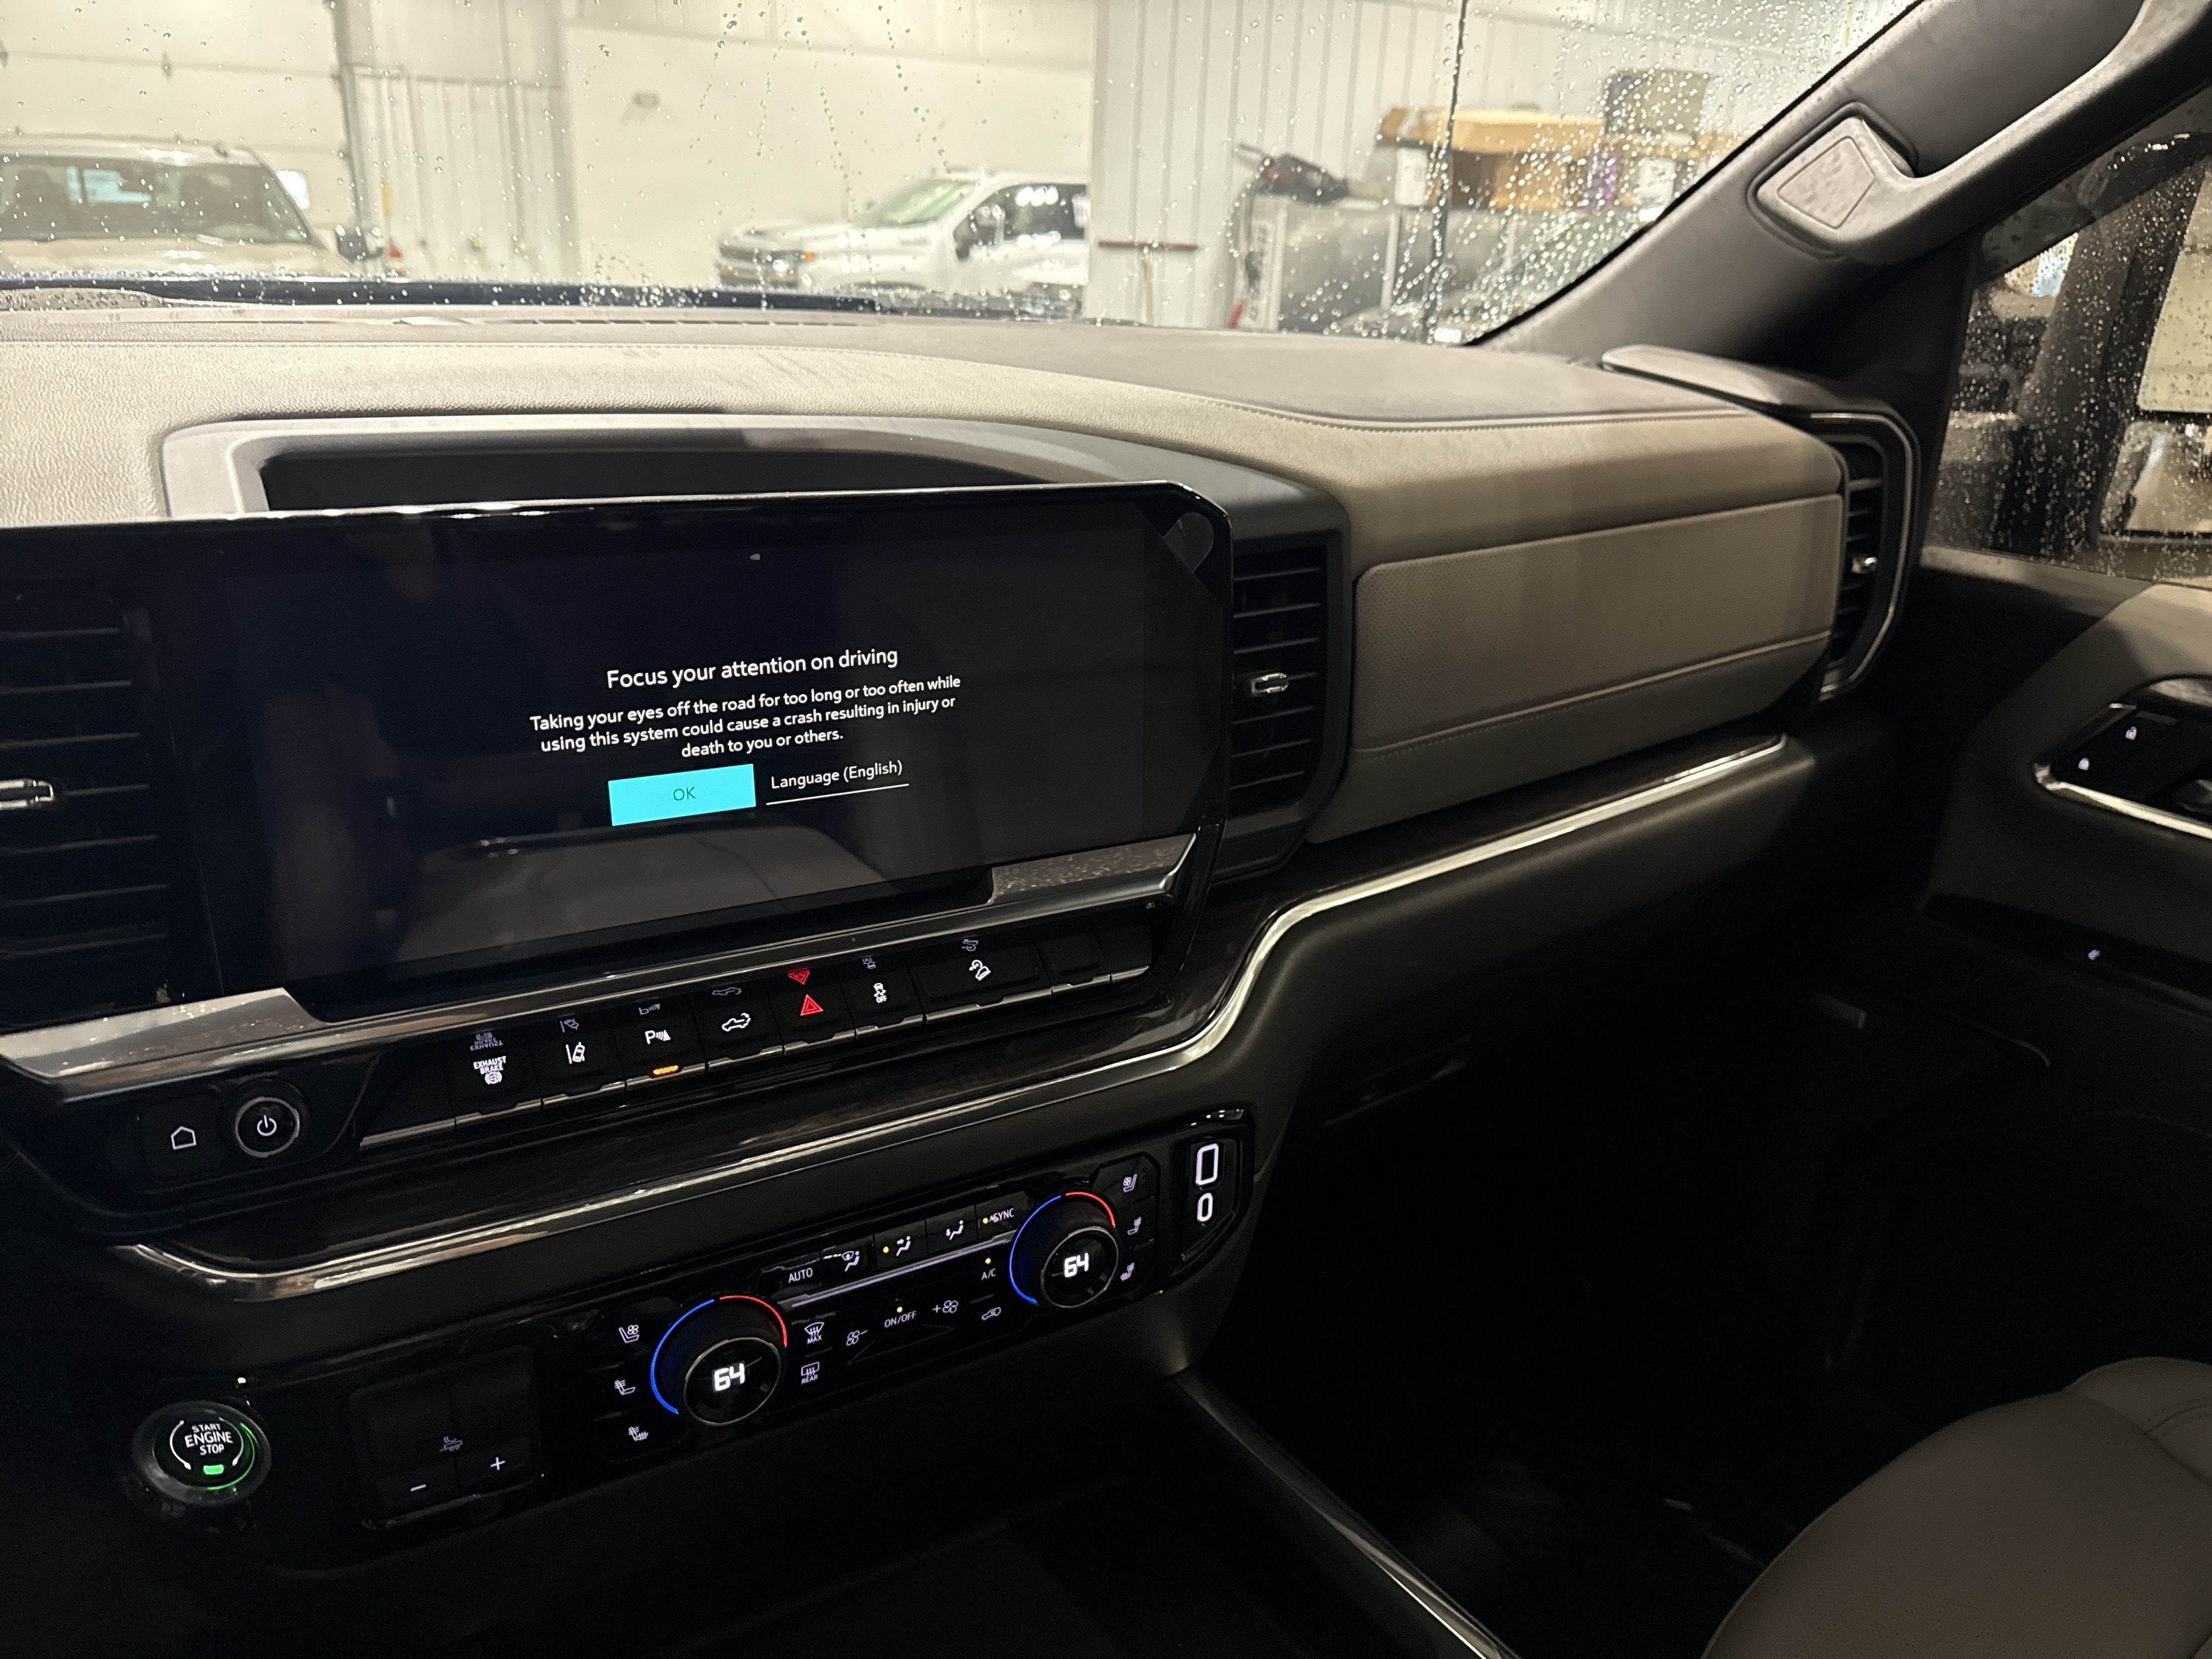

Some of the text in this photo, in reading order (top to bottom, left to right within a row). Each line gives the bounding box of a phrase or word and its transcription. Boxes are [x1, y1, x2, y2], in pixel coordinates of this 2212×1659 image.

[607, 648, 898, 689] Focus your attention on driving
[529, 674, 961, 731] Taking your eyes off the road for too long or too often while
[541, 697, 956, 752] using this system could cause a crash resulting in injury or
[681, 729, 844, 758] death to you or others.
[771, 759, 902, 789] Language (English)
[673, 786, 696, 802] OK
[473, 1056, 506, 1069] EXHAUST
[479, 1063, 504, 1075] BRAKE
[992, 1207, 1015, 1223] SYNC
[1064, 1252, 1089, 1278] 64
[788, 1267, 814, 1284] AUTO
[981, 1268, 996, 1280] A/C
[884, 1310, 917, 1328] ON/OFF
[807, 1334, 822, 1345] MAX
[714, 1363, 746, 1391] 64
[801, 1374, 818, 1385] REAR
[191, 1423, 221, 1434] START
[184, 1430, 234, 1448] ENGINE
[199, 1443, 224, 1456] STOP
